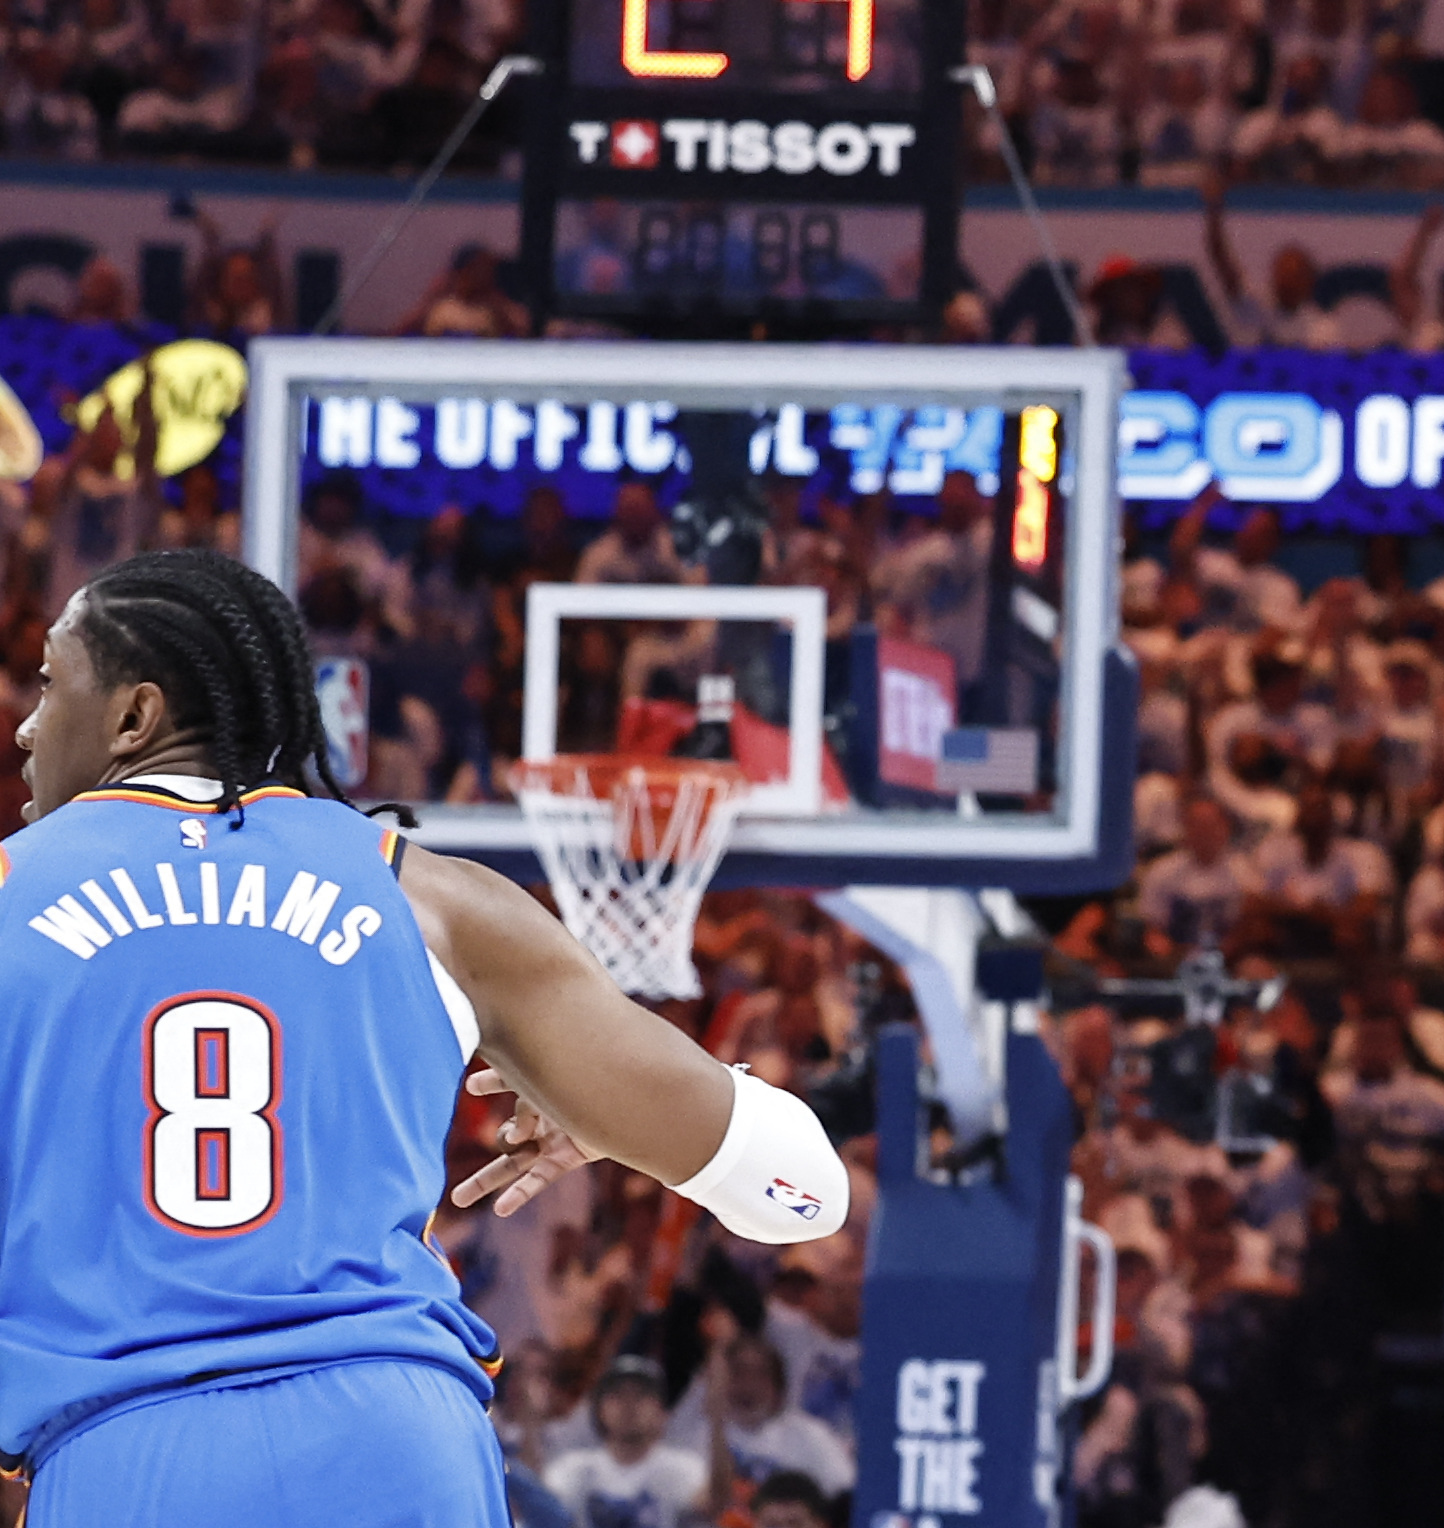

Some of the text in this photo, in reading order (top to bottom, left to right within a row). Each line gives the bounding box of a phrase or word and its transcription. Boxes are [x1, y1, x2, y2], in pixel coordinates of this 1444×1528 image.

[661, 118, 916, 176] TISSOT
[303, 396, 421, 468] HE
[434, 398, 823, 476] OFFICL
[28, 862, 382, 966] WILLIAMS
[141, 989, 284, 1239] 8
[897, 1358, 986, 1434] GET
[895, 1437, 984, 1516] THE
